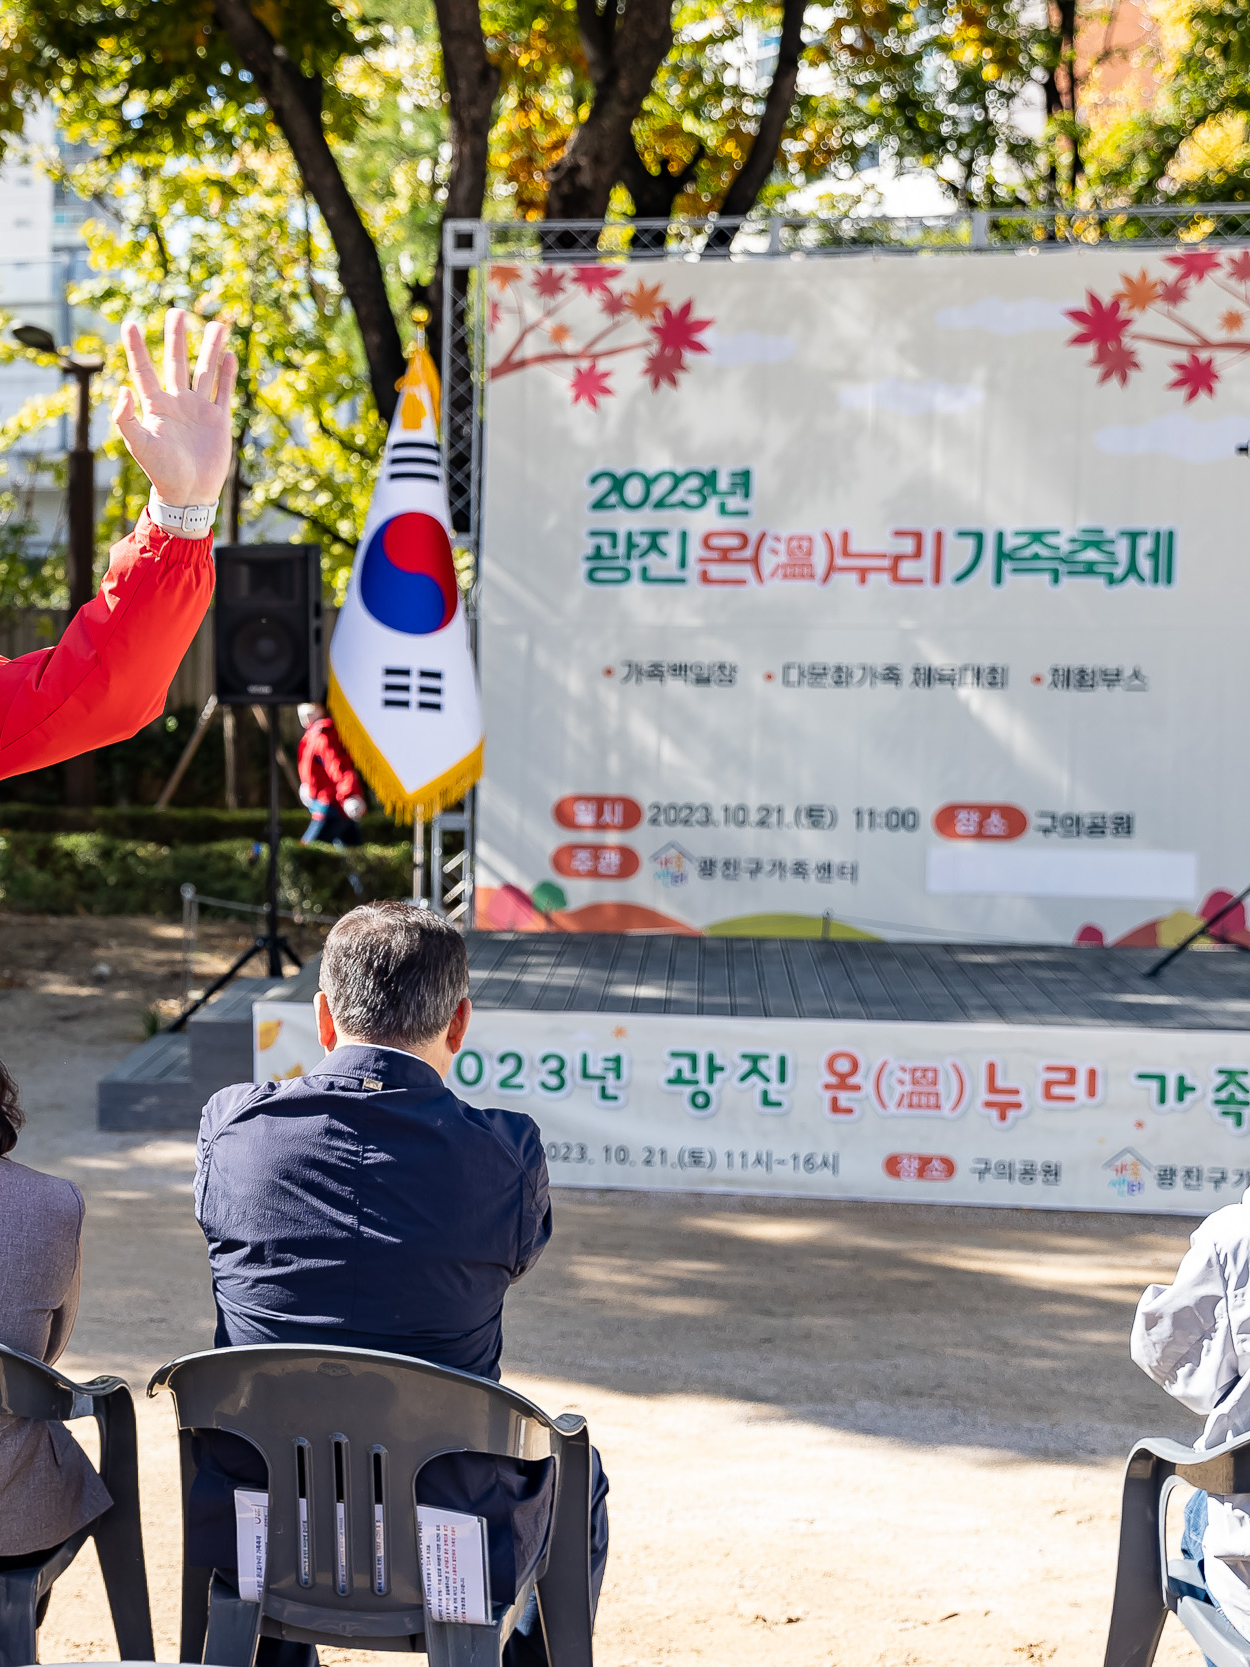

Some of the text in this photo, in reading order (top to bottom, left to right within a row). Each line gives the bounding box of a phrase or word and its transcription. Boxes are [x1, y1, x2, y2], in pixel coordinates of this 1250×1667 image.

[590, 468, 751, 515] 2023년
[586, 530, 687, 584] 광진
[954, 529, 1174, 585] 가족축제
[573, 800, 624, 827] 일시
[853, 806, 920, 832] 11:00
[954, 809, 1009, 836] 장소
[454, 1050, 623, 1101] 023년
[666, 1051, 787, 1110] 광진
[1136, 1066, 1250, 1127] 가족
[896, 1154, 1062, 1186] 장소 구의공원
